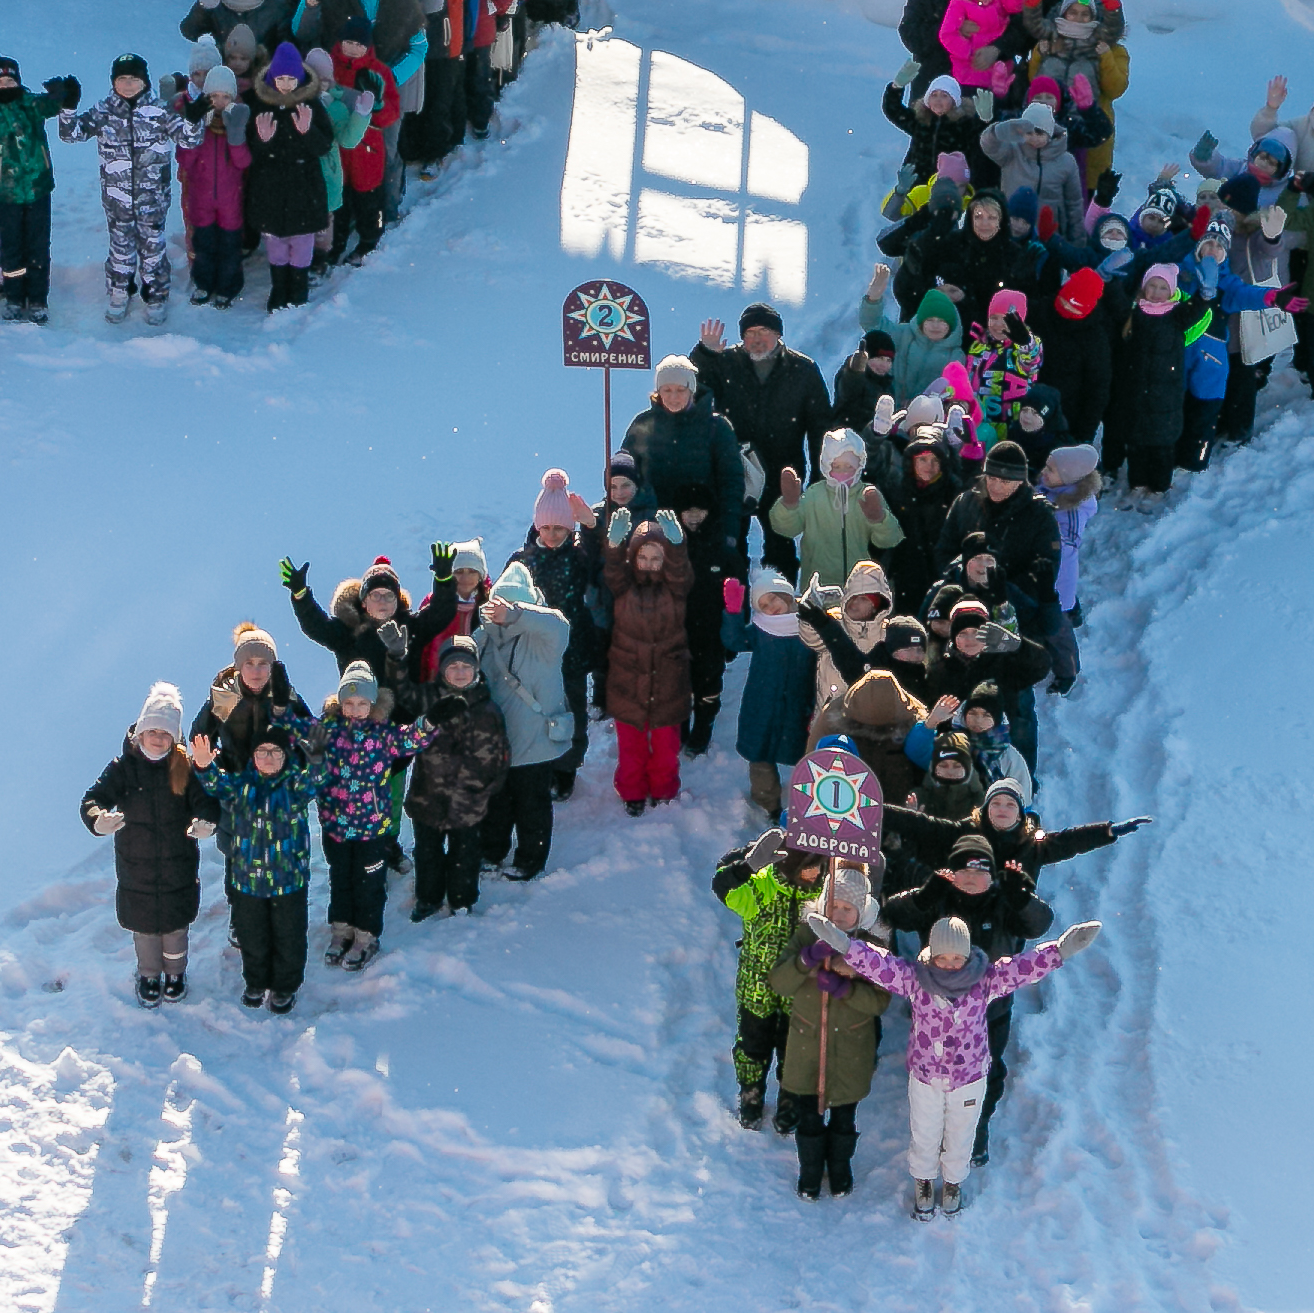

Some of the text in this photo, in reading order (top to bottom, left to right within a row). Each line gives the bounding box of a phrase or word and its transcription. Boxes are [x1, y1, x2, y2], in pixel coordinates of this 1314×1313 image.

[598, 304, 614, 328] 2
[571, 351, 645, 365] СМИРЕНИЕ
[796, 832, 869, 858] ДОБРОТА
